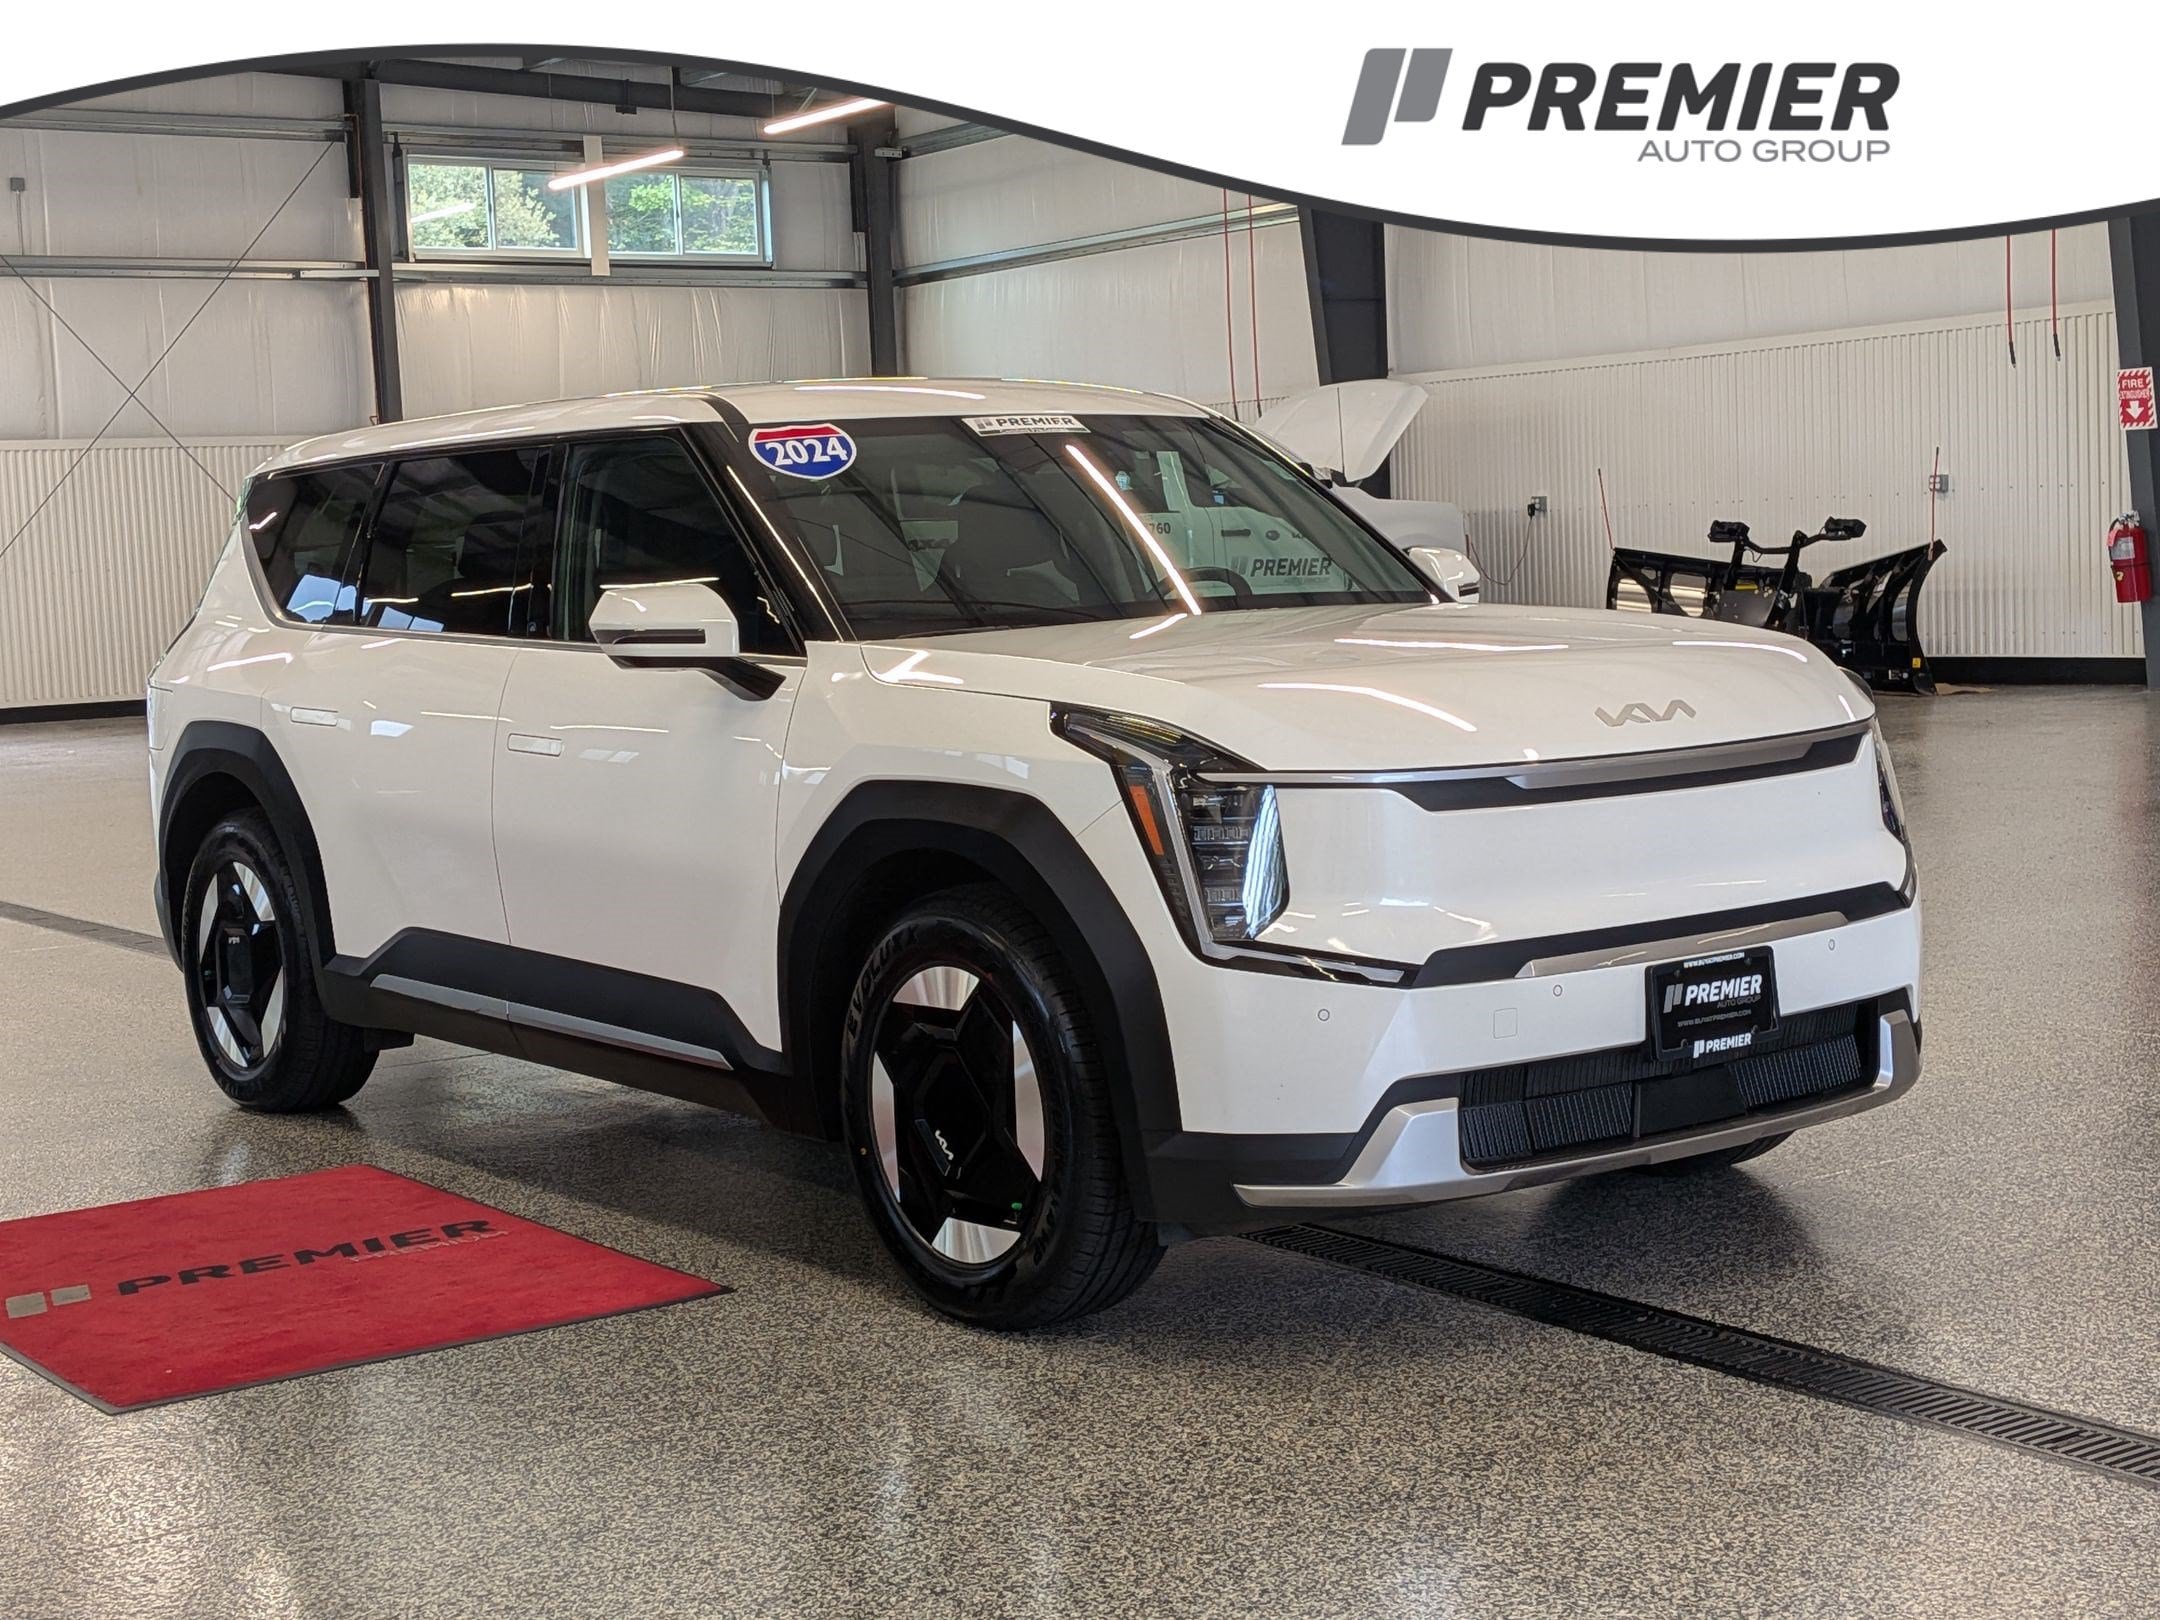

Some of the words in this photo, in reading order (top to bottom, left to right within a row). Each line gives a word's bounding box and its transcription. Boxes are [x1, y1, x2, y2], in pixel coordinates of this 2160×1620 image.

[2121, 378, 2145, 389] FIRE
[995, 416, 1075, 427] PREMIER
[765, 437, 848, 466] 2024
[1250, 557, 1332, 578] PREMIER
[1684, 974, 1763, 1007] PREMIER
[1716, 999, 1736, 1009] AUTO
[1737, 994, 1761, 1006] GROUP
[1705, 1032, 1752, 1053] PREMIER
[118, 1219, 497, 1296] PREMIER
